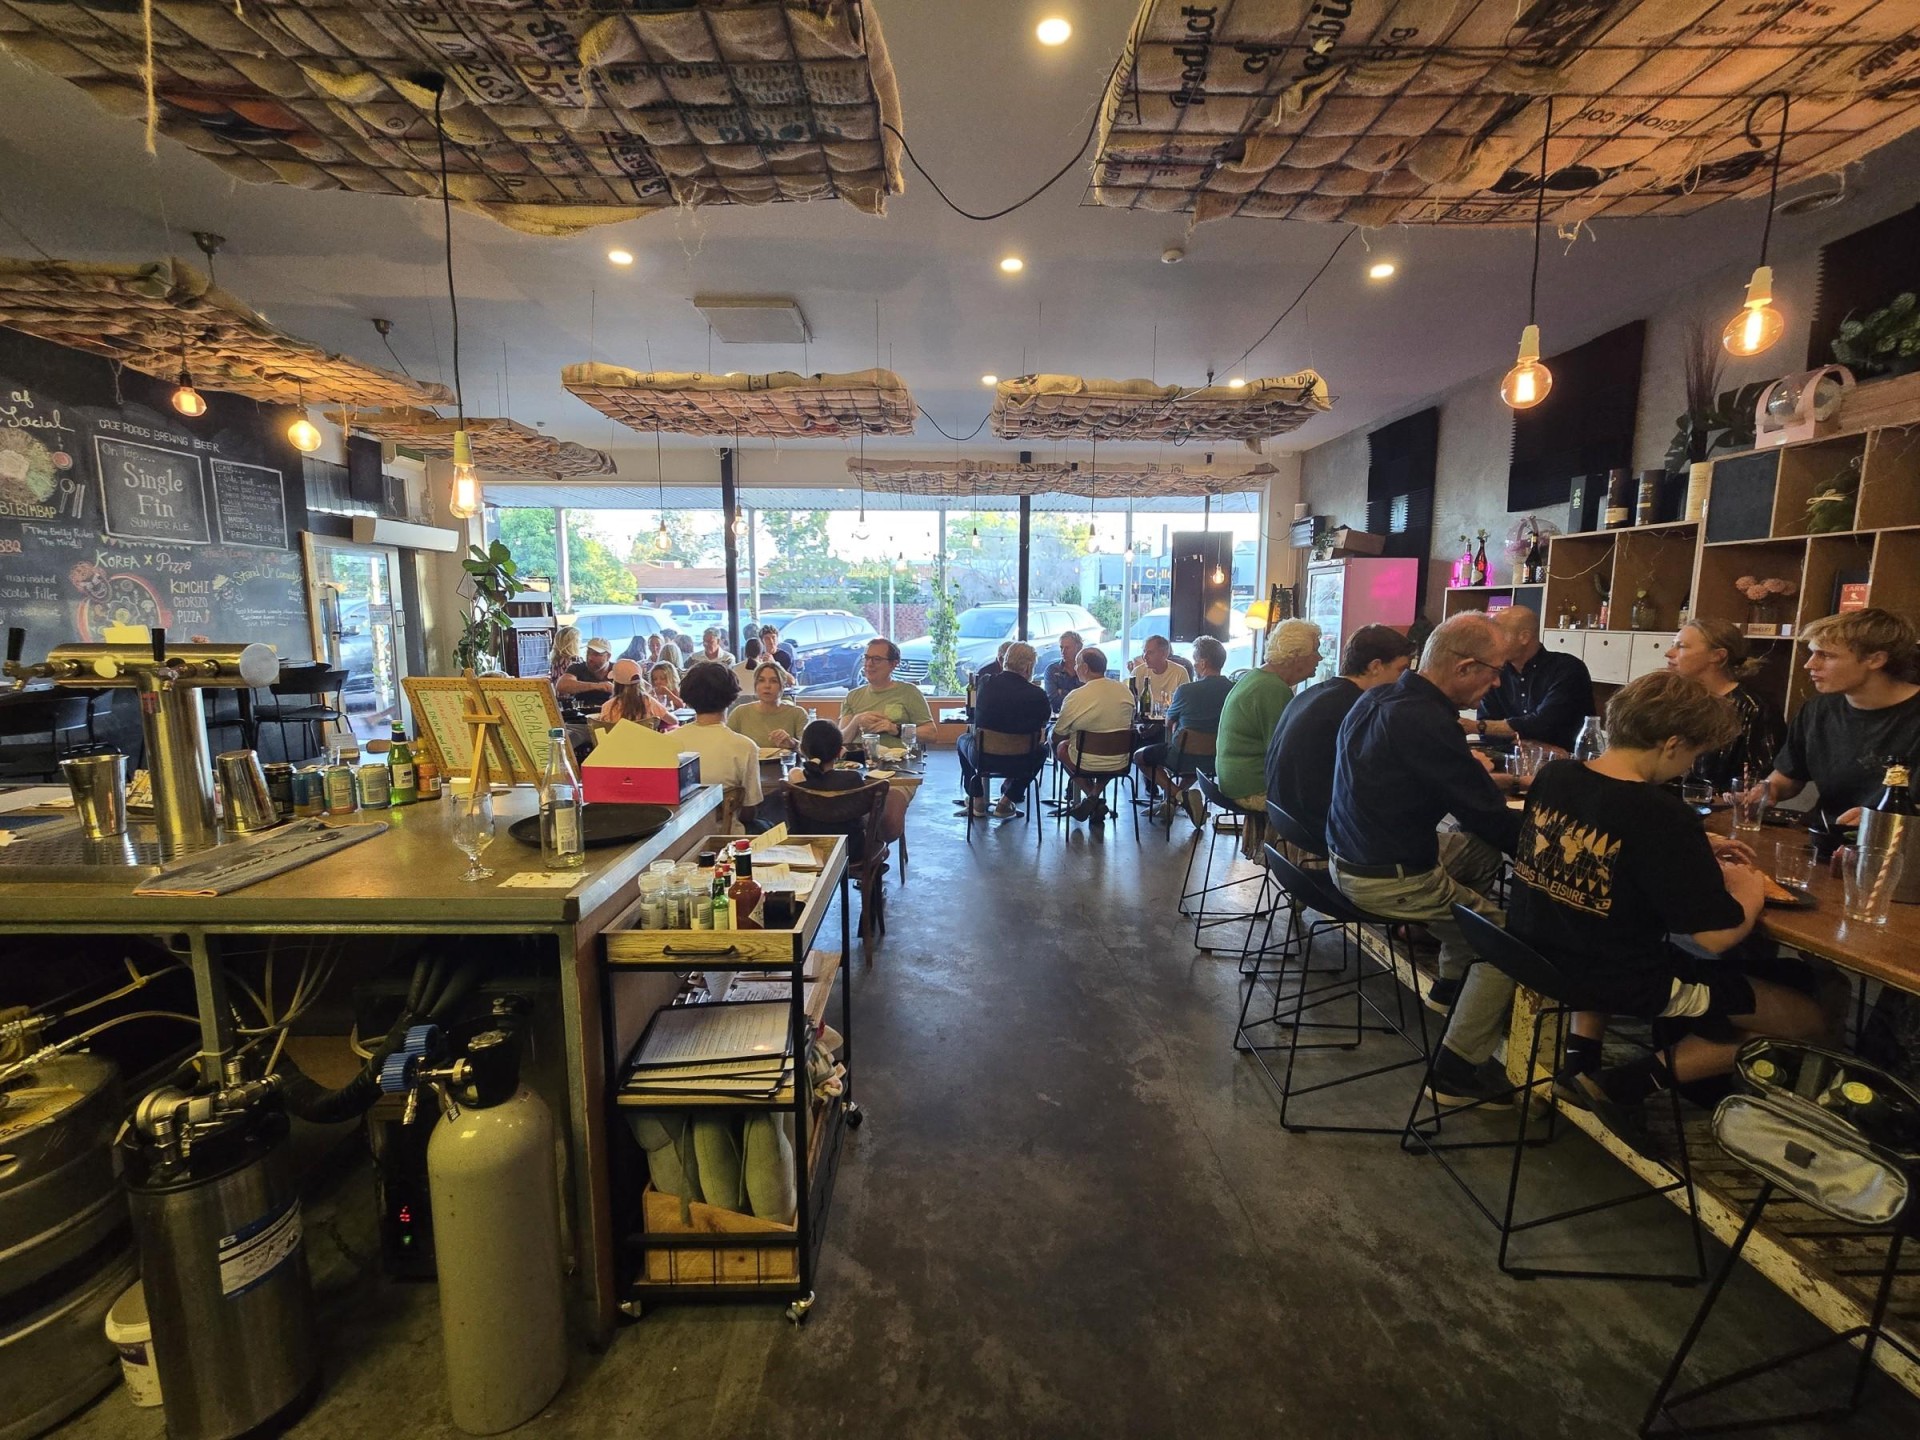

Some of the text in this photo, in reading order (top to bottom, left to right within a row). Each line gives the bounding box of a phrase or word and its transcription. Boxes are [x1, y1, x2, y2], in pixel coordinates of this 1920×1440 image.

[193, 439, 220, 453] BEER
[123, 462, 184, 495] Single
[138, 494, 175, 518] Fin
[95, 549, 141, 569] KOREA
[170, 579, 210, 593] KIMCHI
[177, 609, 202, 624] PIZZA
